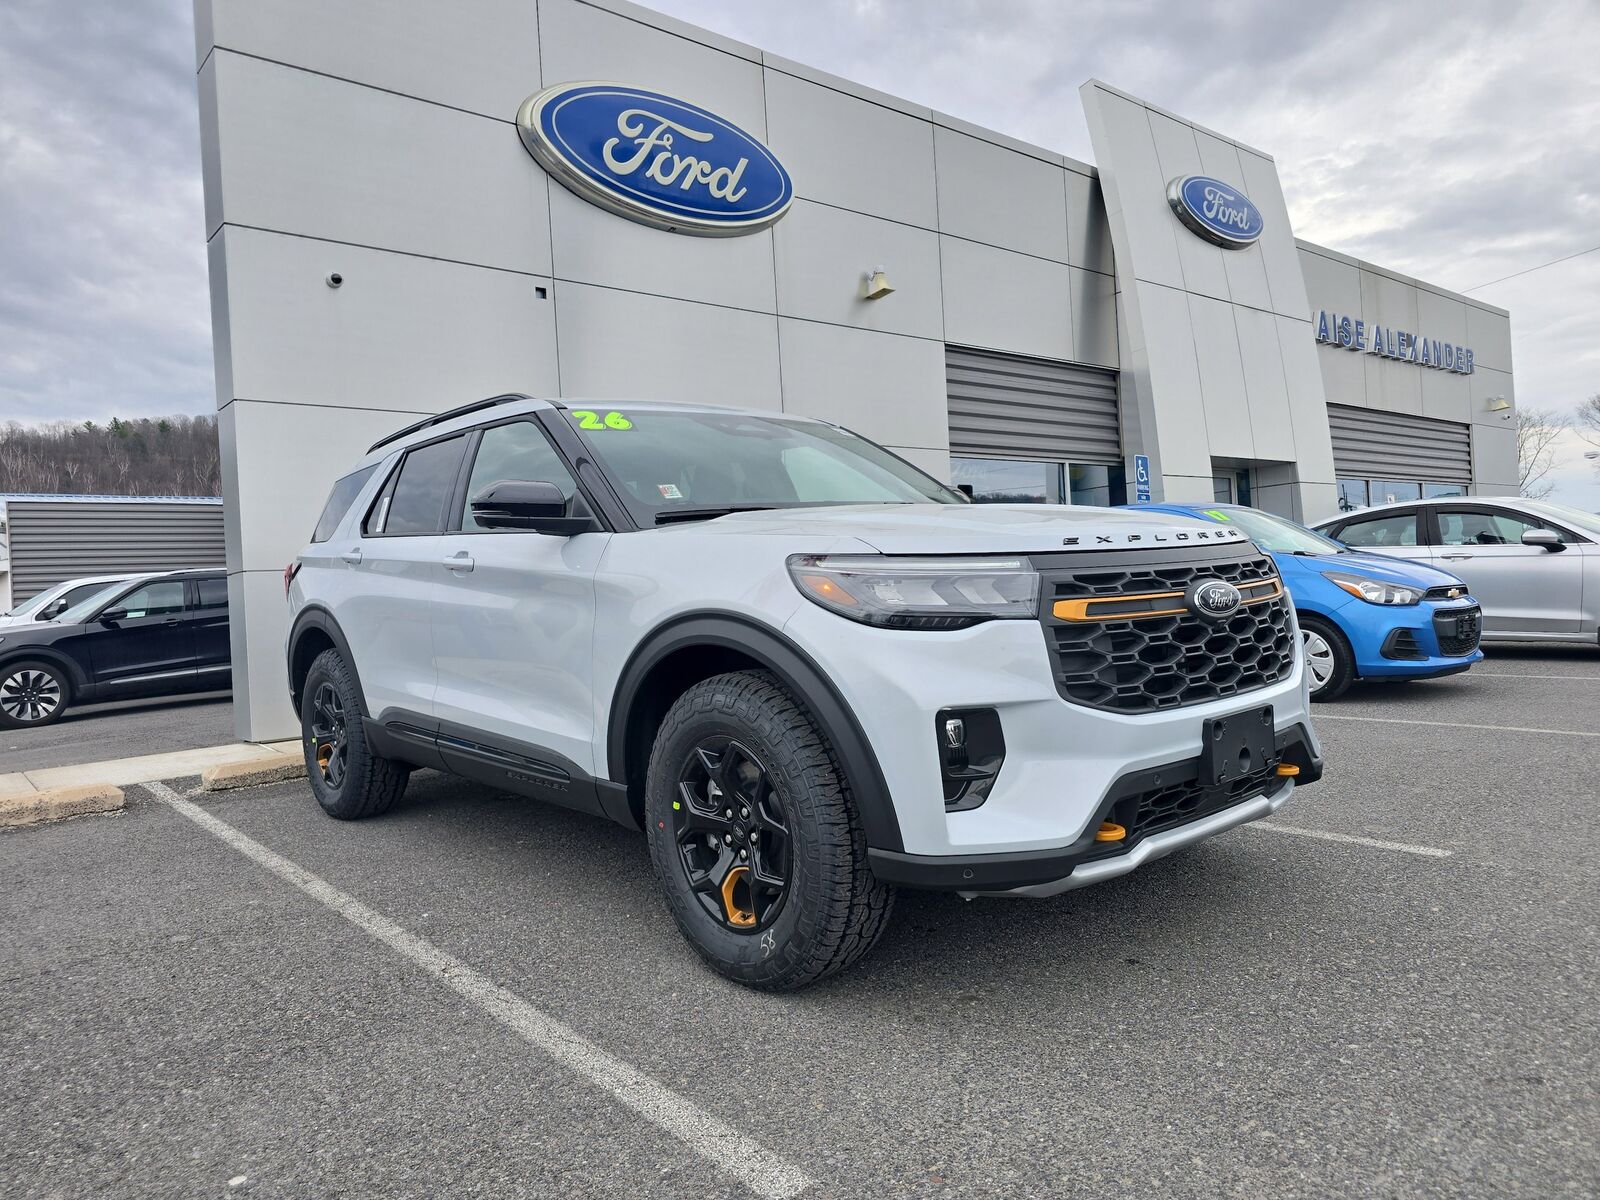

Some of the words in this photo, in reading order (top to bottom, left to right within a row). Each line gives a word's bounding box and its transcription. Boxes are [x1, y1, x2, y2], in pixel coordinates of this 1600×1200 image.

[602, 108, 750, 203] Ford
[1202, 186, 1250, 230] Ford
[1368, 323, 1476, 375] ALEXANDER
[571, 410, 633, 431] 26
[1062, 529, 1239, 546] EXPLORER
[1209, 588, 1234, 608] Ford
